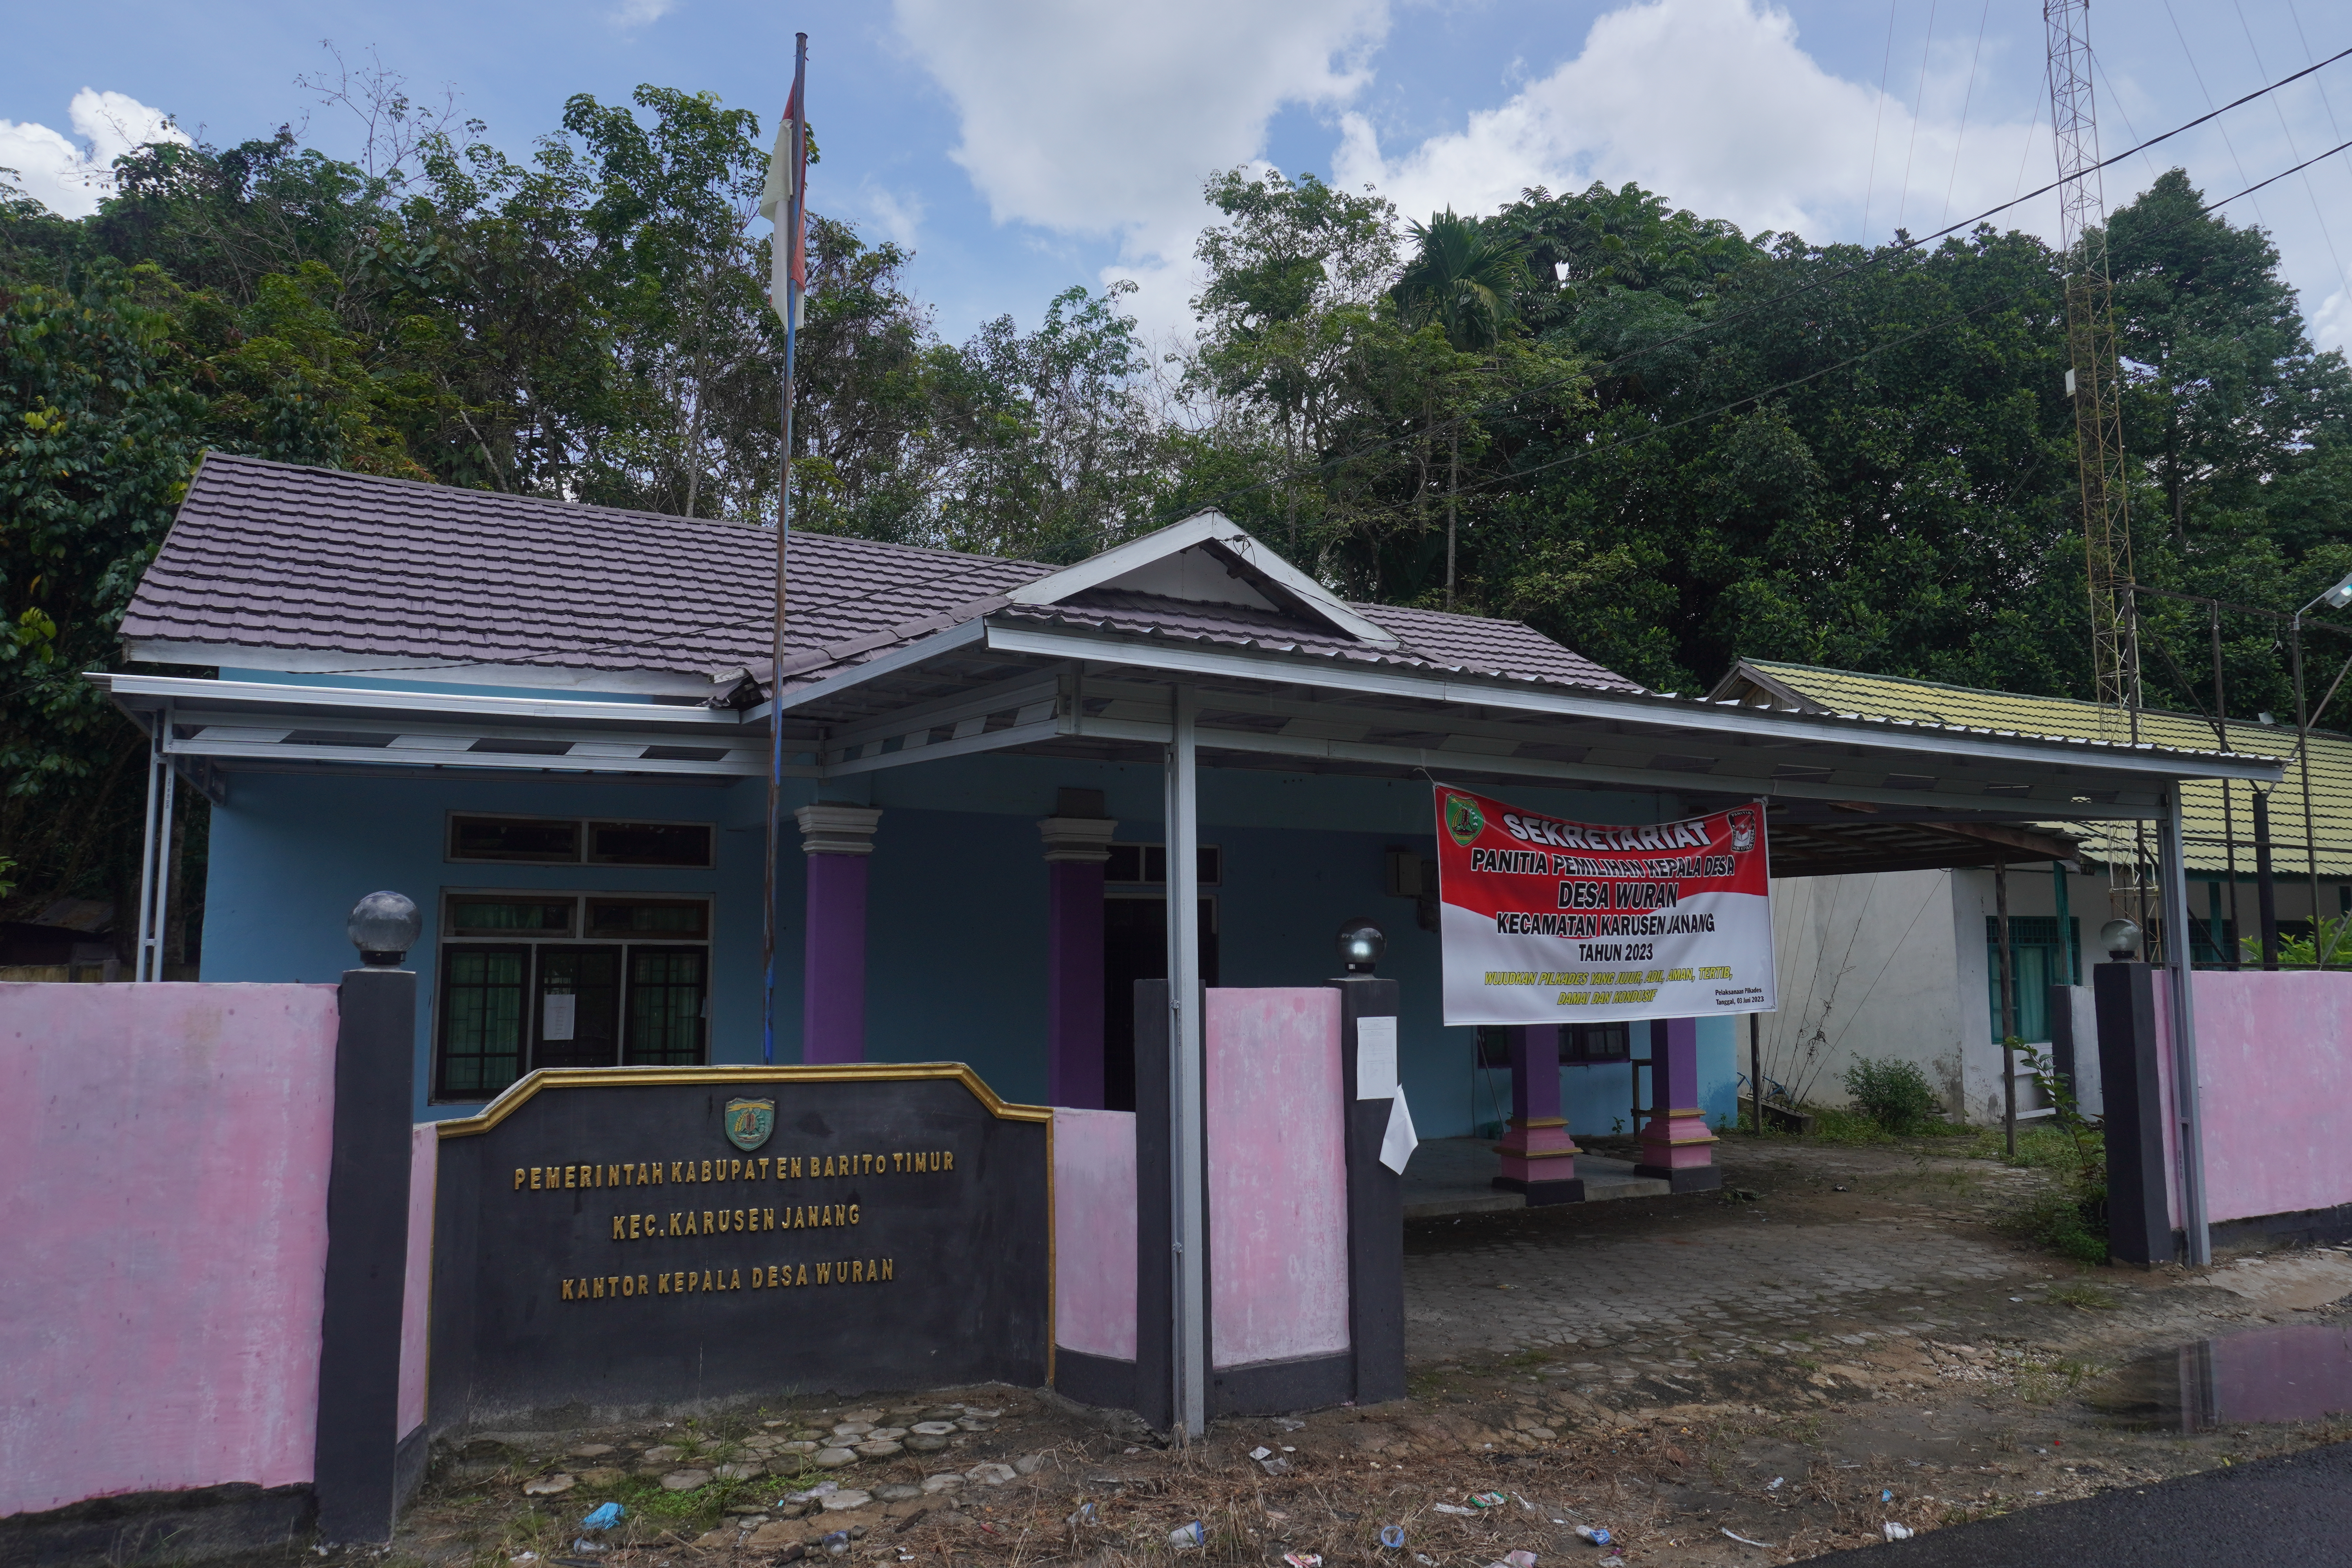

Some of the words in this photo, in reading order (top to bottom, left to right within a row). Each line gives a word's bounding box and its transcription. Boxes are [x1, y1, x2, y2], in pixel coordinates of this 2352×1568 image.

[1503, 812, 1713, 852] SEKRETARIAT
[1471, 847, 1548, 875] PANITIA
[1552, 853, 1645, 877] PEMILIHAN
[1646, 856, 1701, 878] KEPALA
[1703, 855, 1735, 878] DESA
[1558, 880, 1609, 910] DESA
[1615, 882, 1680, 910] WURAN
[1496, 911, 1596, 937] KECAMATAN
[1600, 914, 1666, 936] KARUSEN
[1666, 913, 1715, 935] JANANG
[1579, 944, 1621, 962] TAHUN
[1625, 943, 1653, 961] 2023
[1485, 971, 1537, 985] WUJUDKAN
[1538, 971, 1588, 985] PILKADES
[1590, 971, 1614, 985] YANG
[1615, 971, 1642, 986] JUJUR,
[1666, 968, 1695, 982] AMAN,
[1699, 966, 1733, 980] TERTIB,
[1557, 991, 1591, 1005] DAMAI
[1591, 991, 1612, 1004] DAN
[1612, 989, 1657, 1004] KONDUSIF
[514, 1162, 663, 1190] PEMERINTAH
[671, 1156, 801, 1183] KABUPATEN
[810, 1154, 886, 1177] BARITO
[893, 1151, 954, 1173] TIMUR
[782, 1204, 860, 1229] JANANG
[562, 1275, 649, 1300] KANTOR
[658, 1269, 740, 1294] KEPALA
[752, 1263, 808, 1289] DESA
[816, 1259, 893, 1284] WURAN
